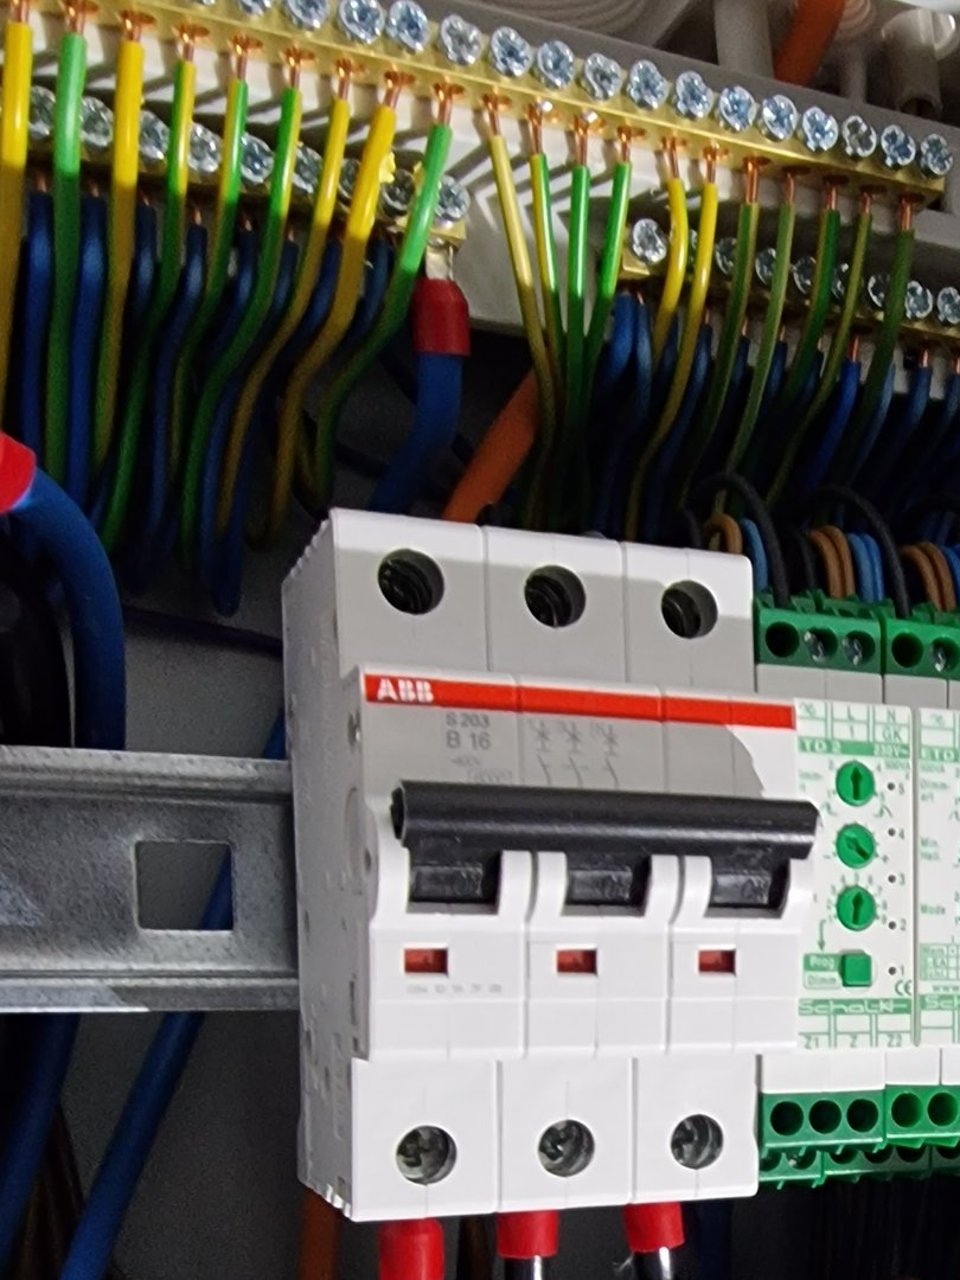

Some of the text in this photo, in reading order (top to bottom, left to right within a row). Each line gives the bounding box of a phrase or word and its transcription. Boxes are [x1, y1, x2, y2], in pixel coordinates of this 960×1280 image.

[377, 678, 434, 703] ABB
[446, 712, 490, 728] S 203
[446, 731, 490, 750] B 16
